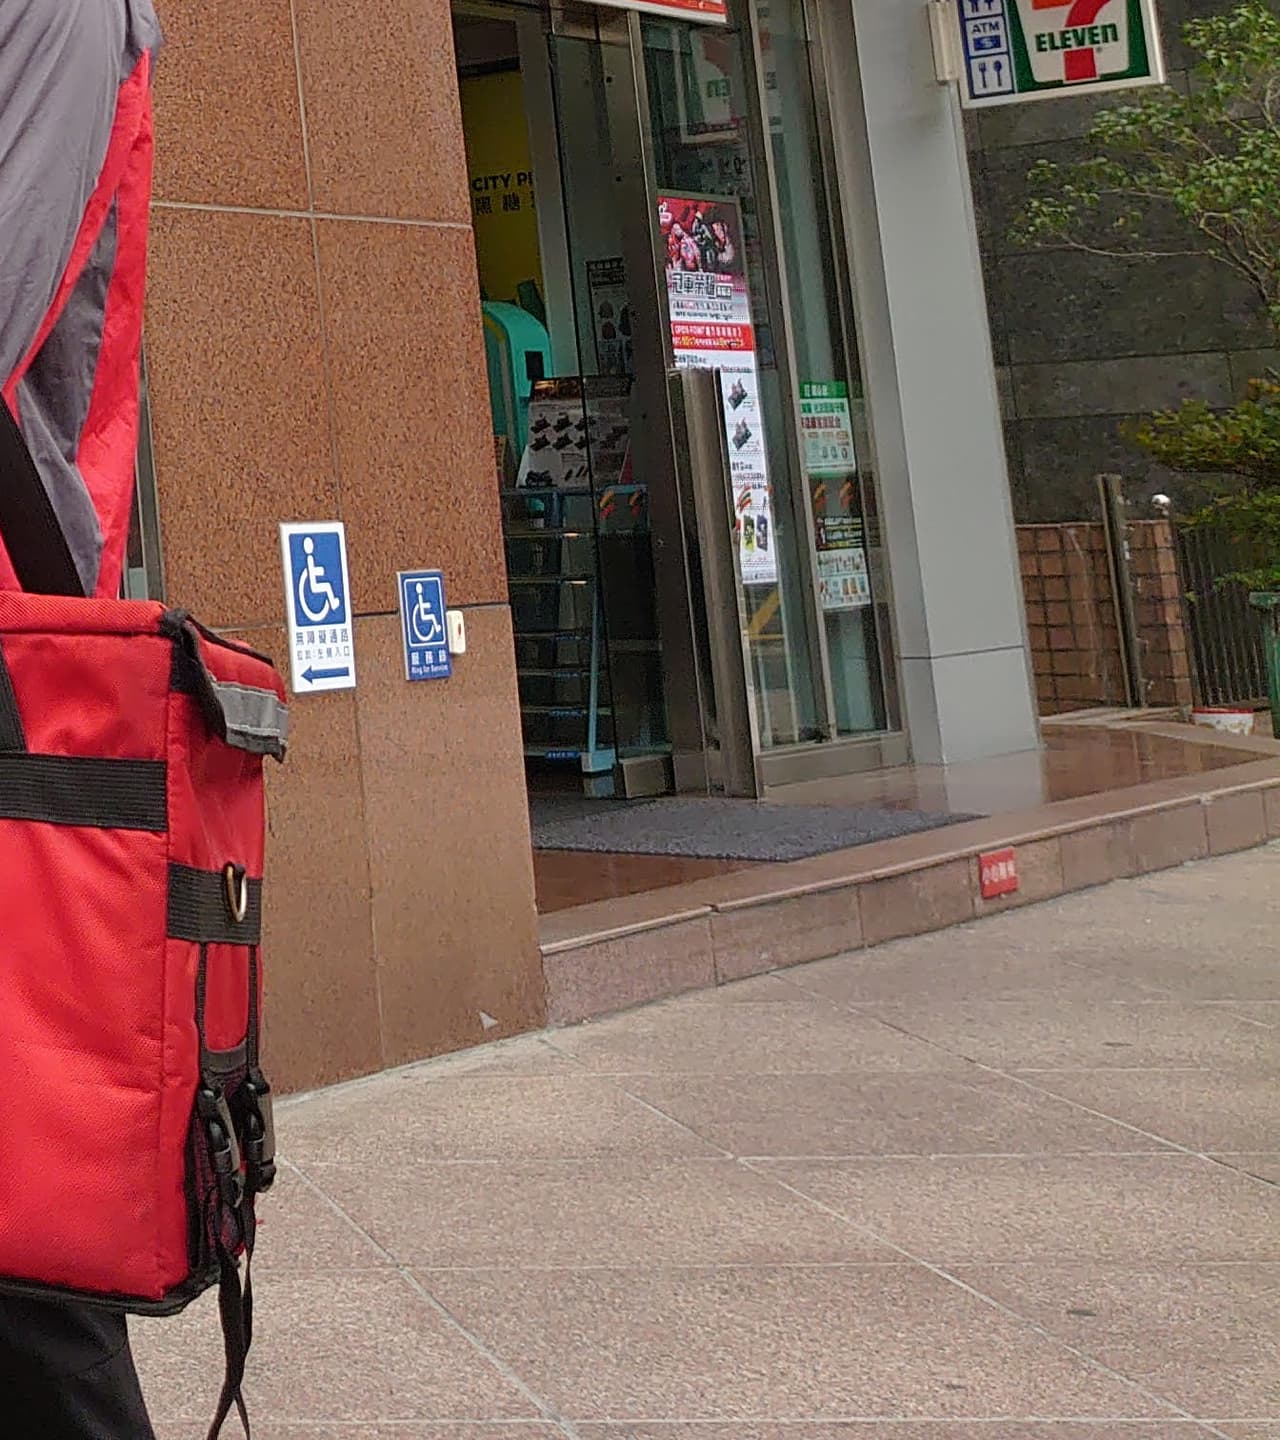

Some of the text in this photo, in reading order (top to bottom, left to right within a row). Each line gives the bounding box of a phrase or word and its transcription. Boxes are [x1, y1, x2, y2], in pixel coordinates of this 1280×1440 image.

[971, 21, 1000, 34] ATM
[472, 172, 512, 192] CITY
[475, 190, 534, 216] 黑糖
